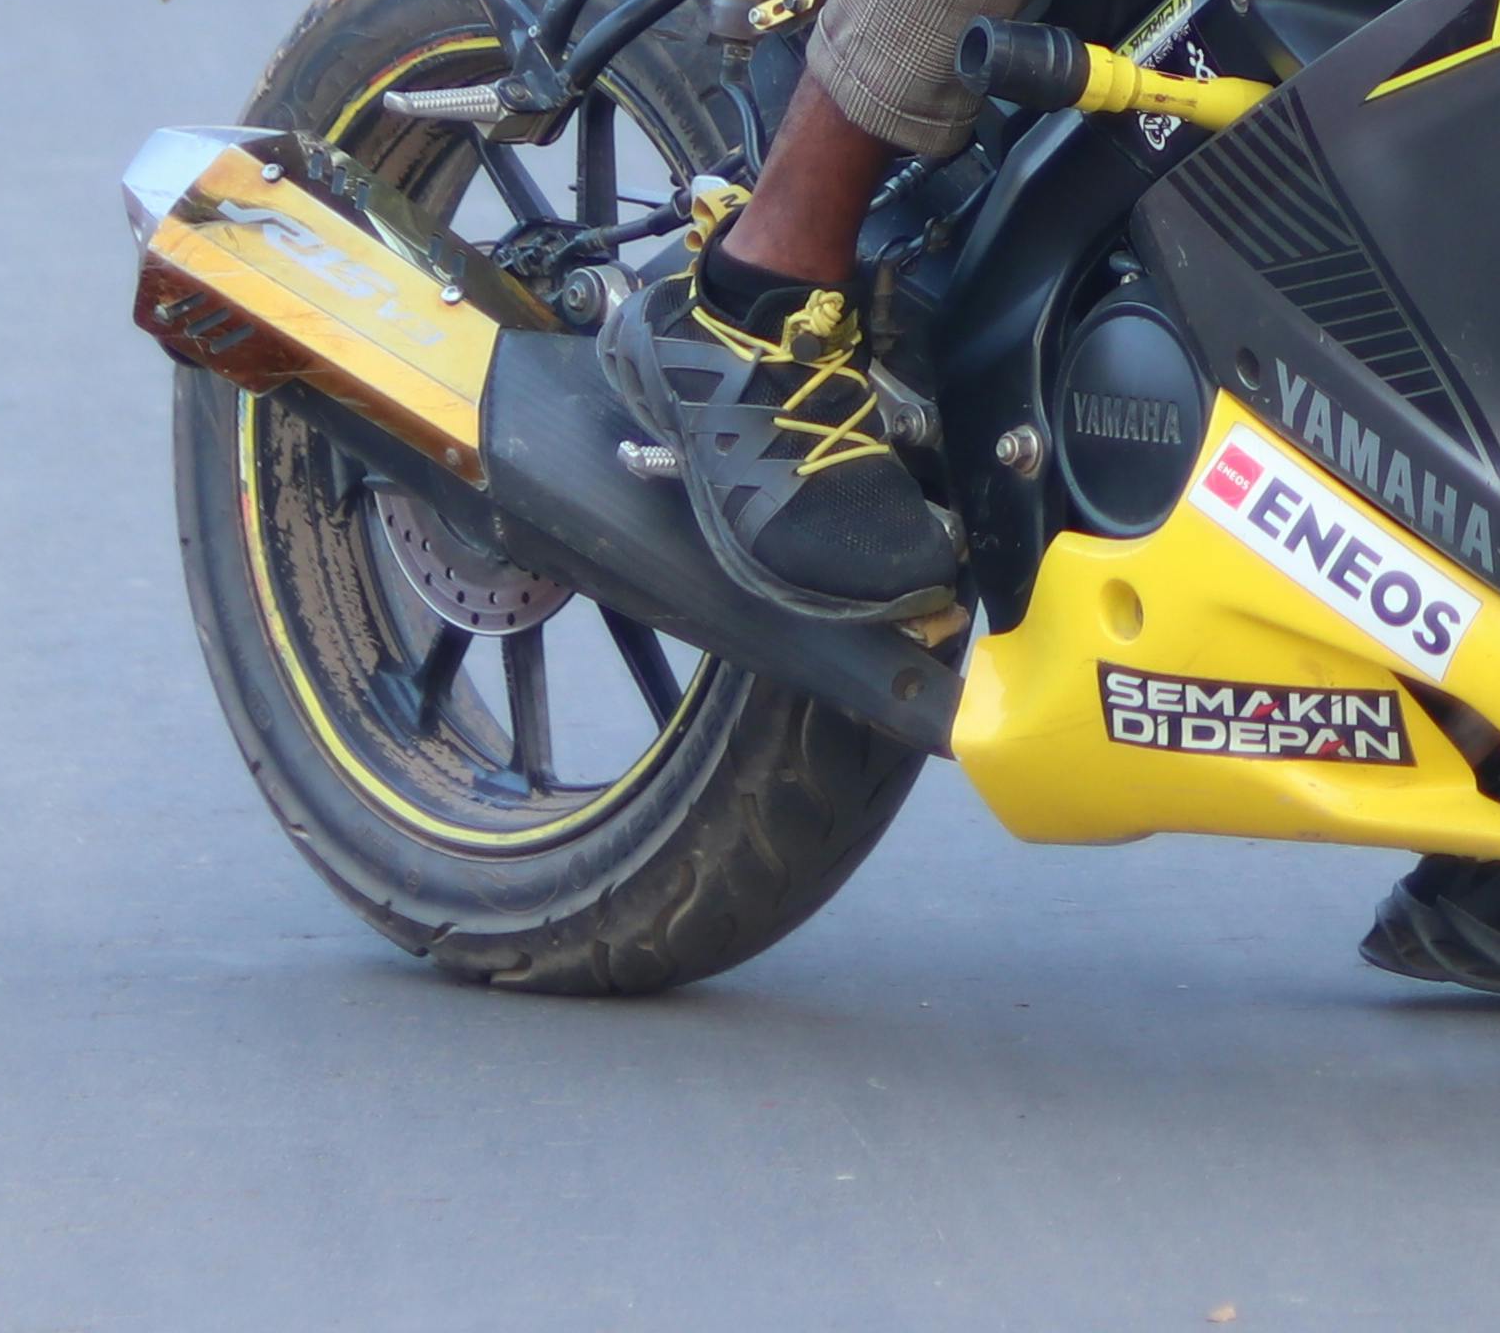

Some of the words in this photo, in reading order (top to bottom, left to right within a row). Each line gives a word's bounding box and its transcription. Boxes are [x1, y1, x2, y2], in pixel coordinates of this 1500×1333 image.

[1073, 390, 1182, 446] YAMAHA
[1216, 460, 1251, 491] ENEOS
[1274, 357, 1496, 574] YAMAHA
[1246, 476, 1462, 656] ENEOS
[1105, 671, 1391, 728] SEMAKIN
[1112, 707, 1169, 747] DI
[1180, 716, 1401, 761] DEPAN
